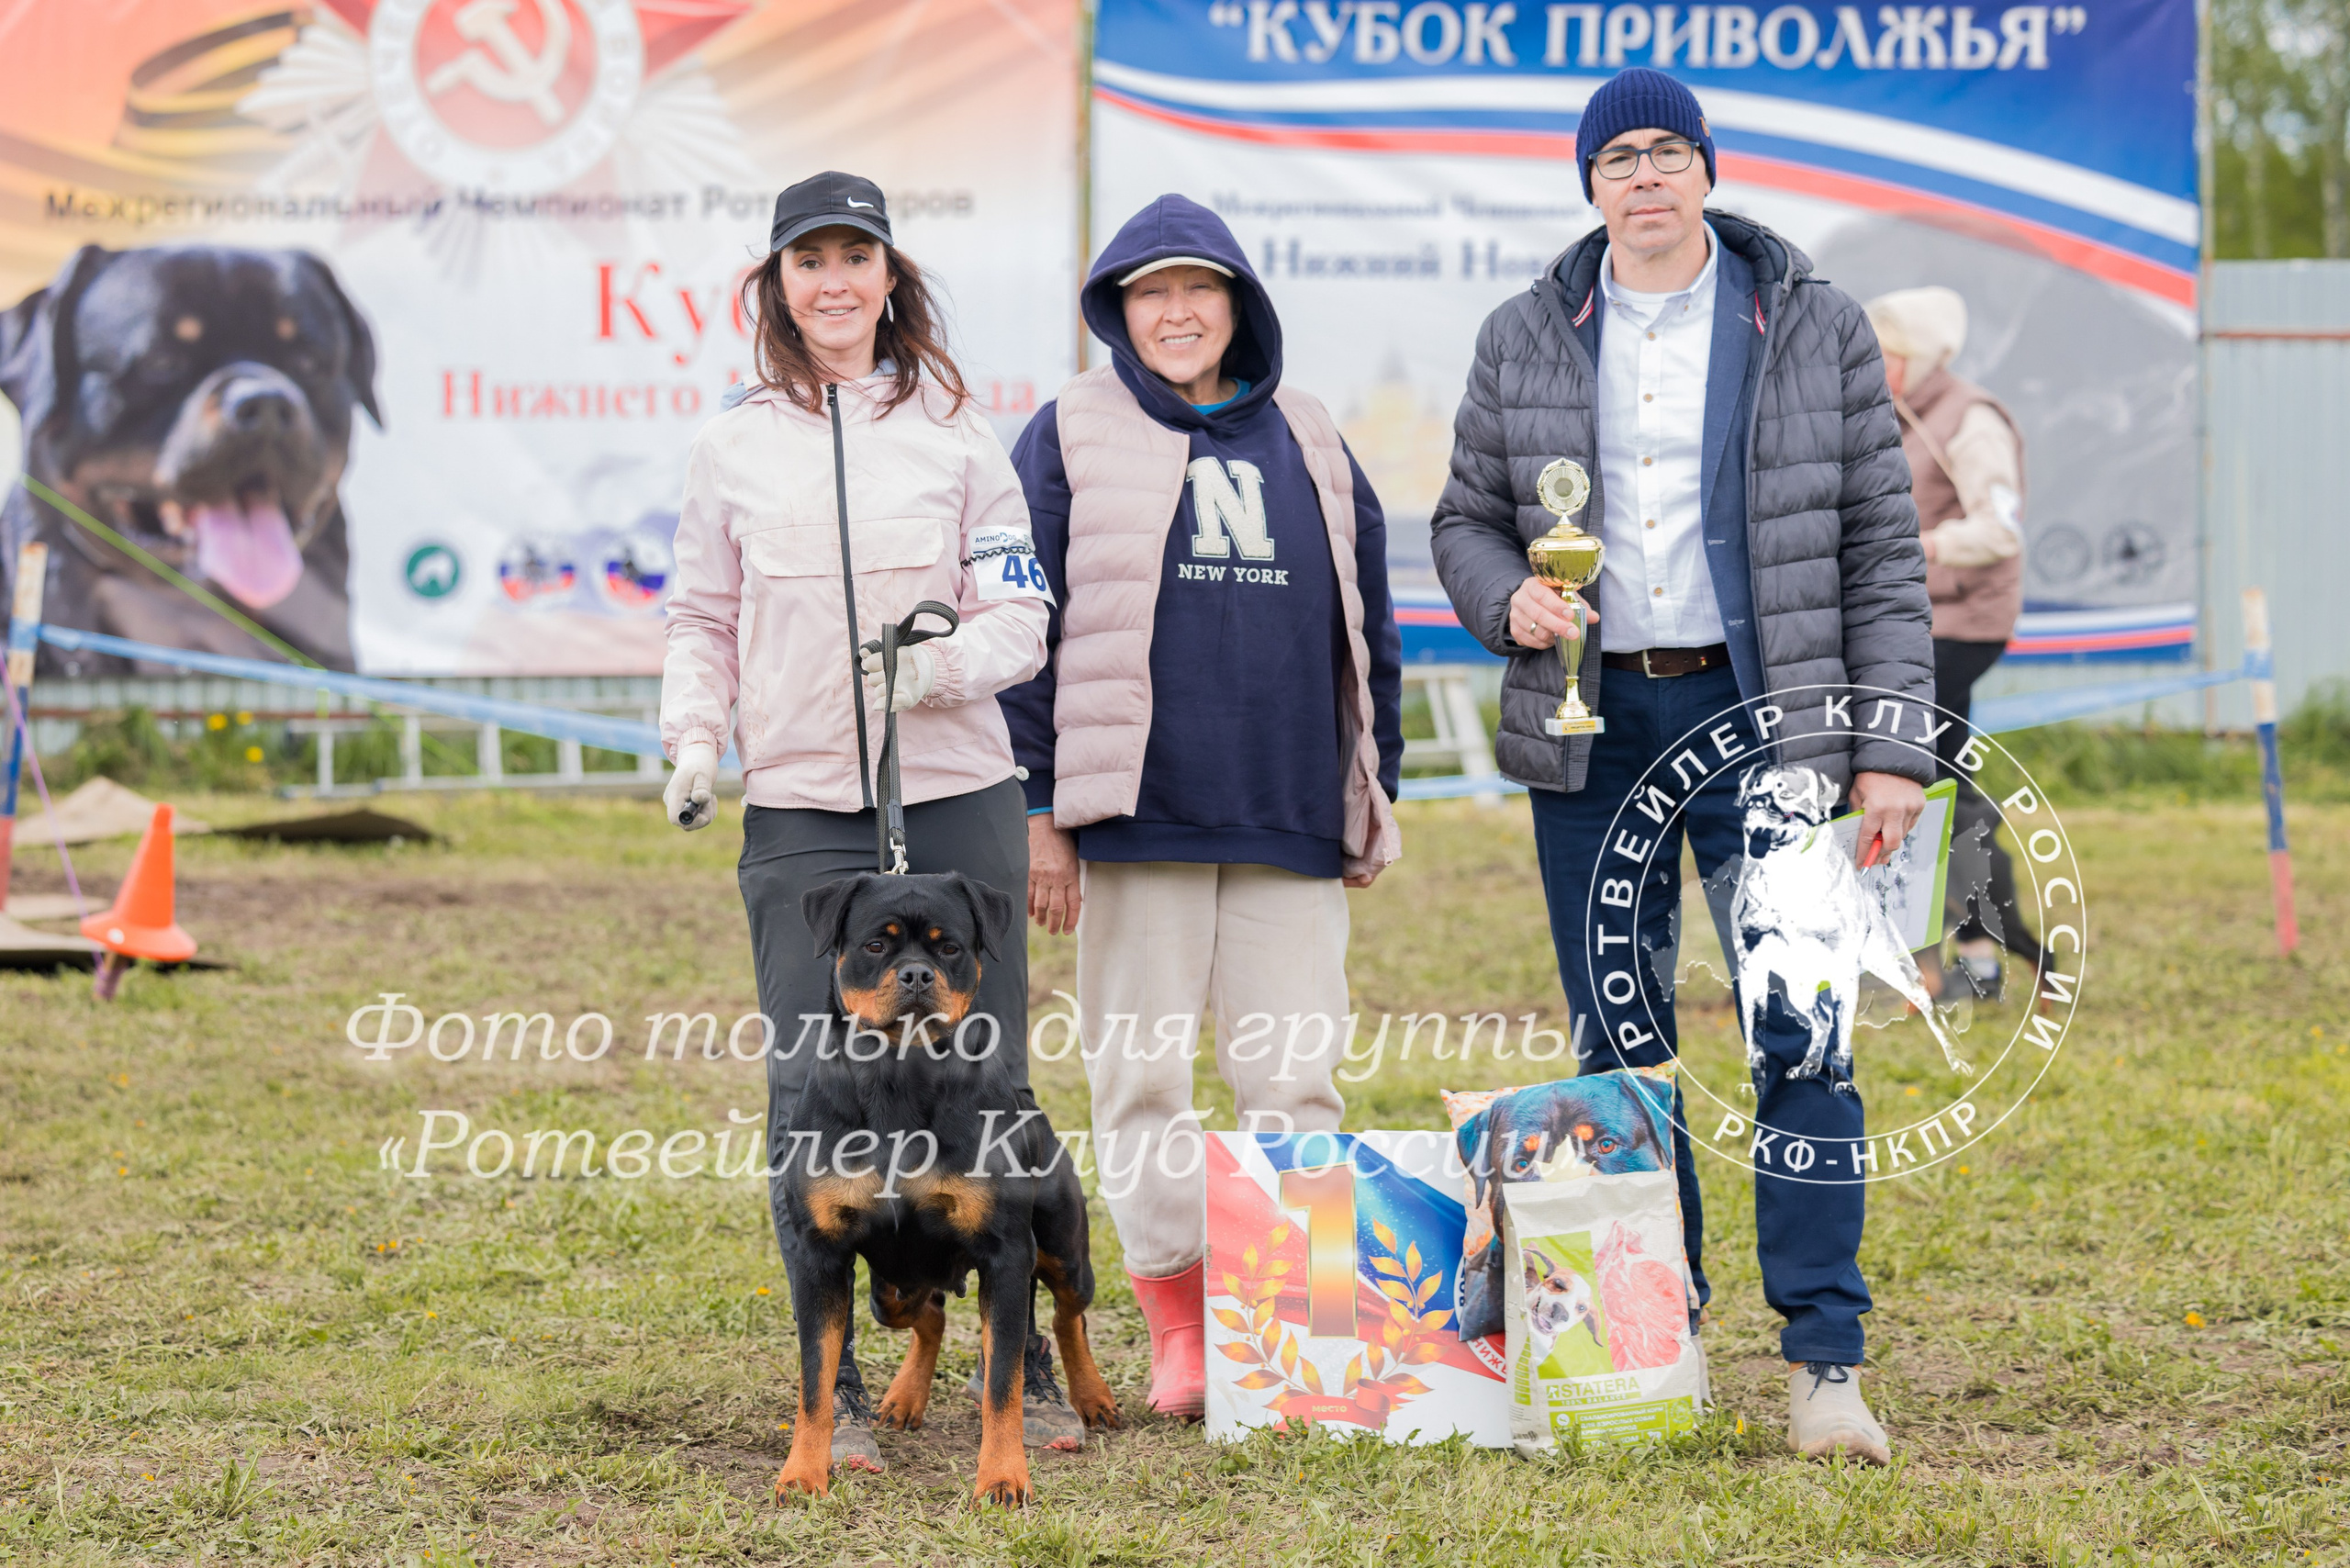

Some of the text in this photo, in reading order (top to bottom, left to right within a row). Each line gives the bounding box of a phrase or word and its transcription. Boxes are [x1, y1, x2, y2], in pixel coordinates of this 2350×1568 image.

[441, 371, 701, 419] Нижнего
[1186, 456, 1275, 562] N
[1002, 554, 1046, 592] 46
[1178, 563, 1289, 586] NEW YORK
[1280, 1160, 1359, 1339] 1
[1561, 1376, 1640, 1398] STATERA
[1586, 1394, 1627, 1404] BALANCE
[1312, 1405, 1348, 1413] место
